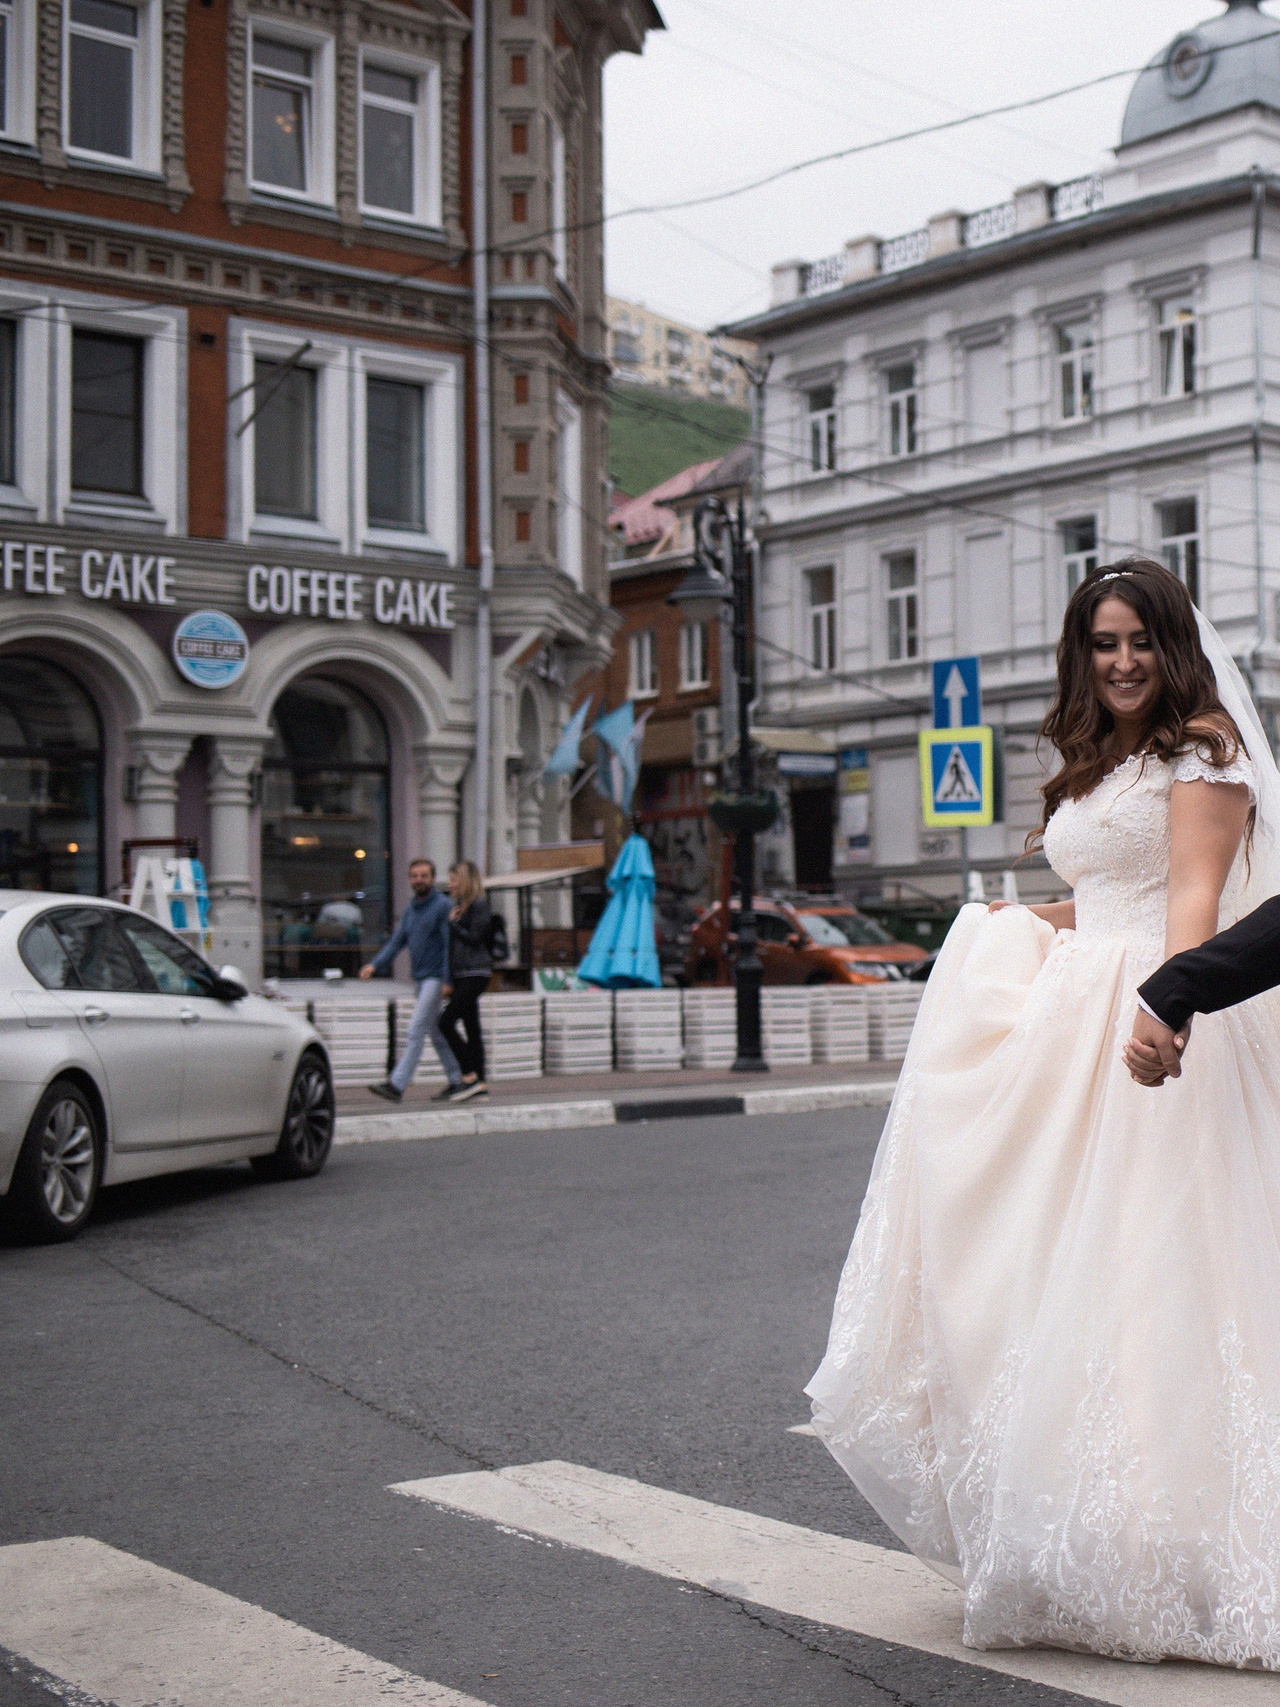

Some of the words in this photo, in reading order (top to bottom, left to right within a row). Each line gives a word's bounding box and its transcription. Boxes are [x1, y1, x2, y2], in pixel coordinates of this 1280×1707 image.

[0, 541, 66, 595] FEE
[81, 549, 177, 605] CAKE
[248, 564, 364, 621] COFFEE
[375, 576, 456, 629] CAKE
